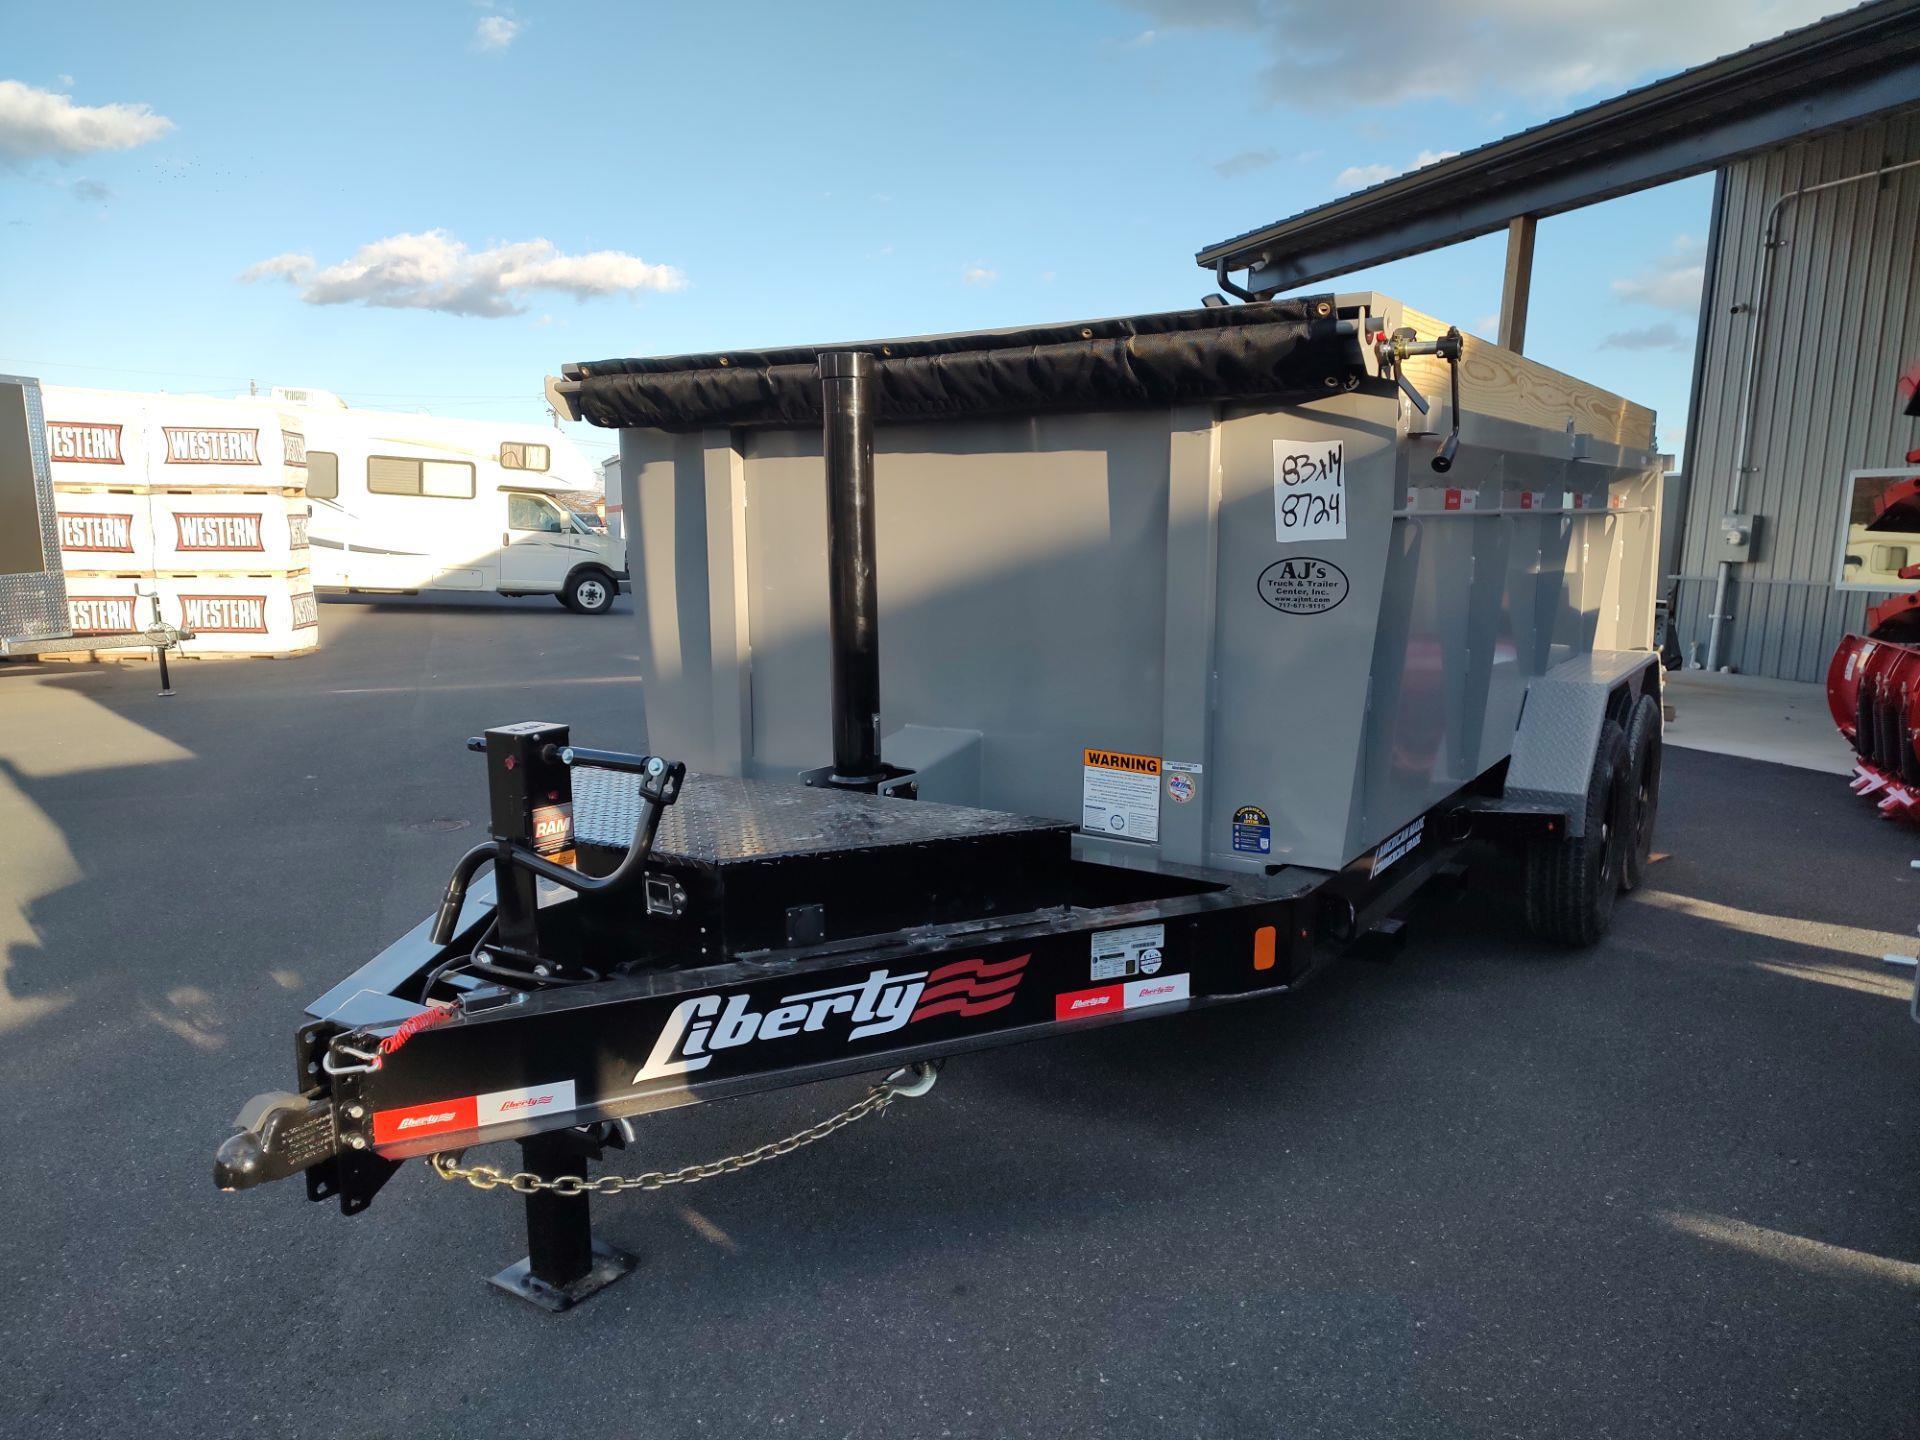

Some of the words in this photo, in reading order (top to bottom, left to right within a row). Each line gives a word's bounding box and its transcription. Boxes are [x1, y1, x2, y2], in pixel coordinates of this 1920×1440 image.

[47, 426, 116, 459] ESTERN
[170, 430, 254, 461] WESTERN
[1282, 493, 1340, 528] 8724
[58, 517, 127, 547] ESTERN
[179, 517, 259, 547] WESTERN
[1268, 579, 1294, 587] Truck
[1280, 561, 1327, 579] AJ's
[1276, 587, 1309, 596] Center,
[68, 600, 131, 629] ESTERN
[184, 599, 261, 628] WESTERN
[1088, 753, 1157, 773] WARNING
[535, 817, 571, 838] RAM
[632, 969, 930, 1086] Liberty
[499, 1097, 538, 1112] Liberty
[397, 1113, 438, 1130] Liberty
